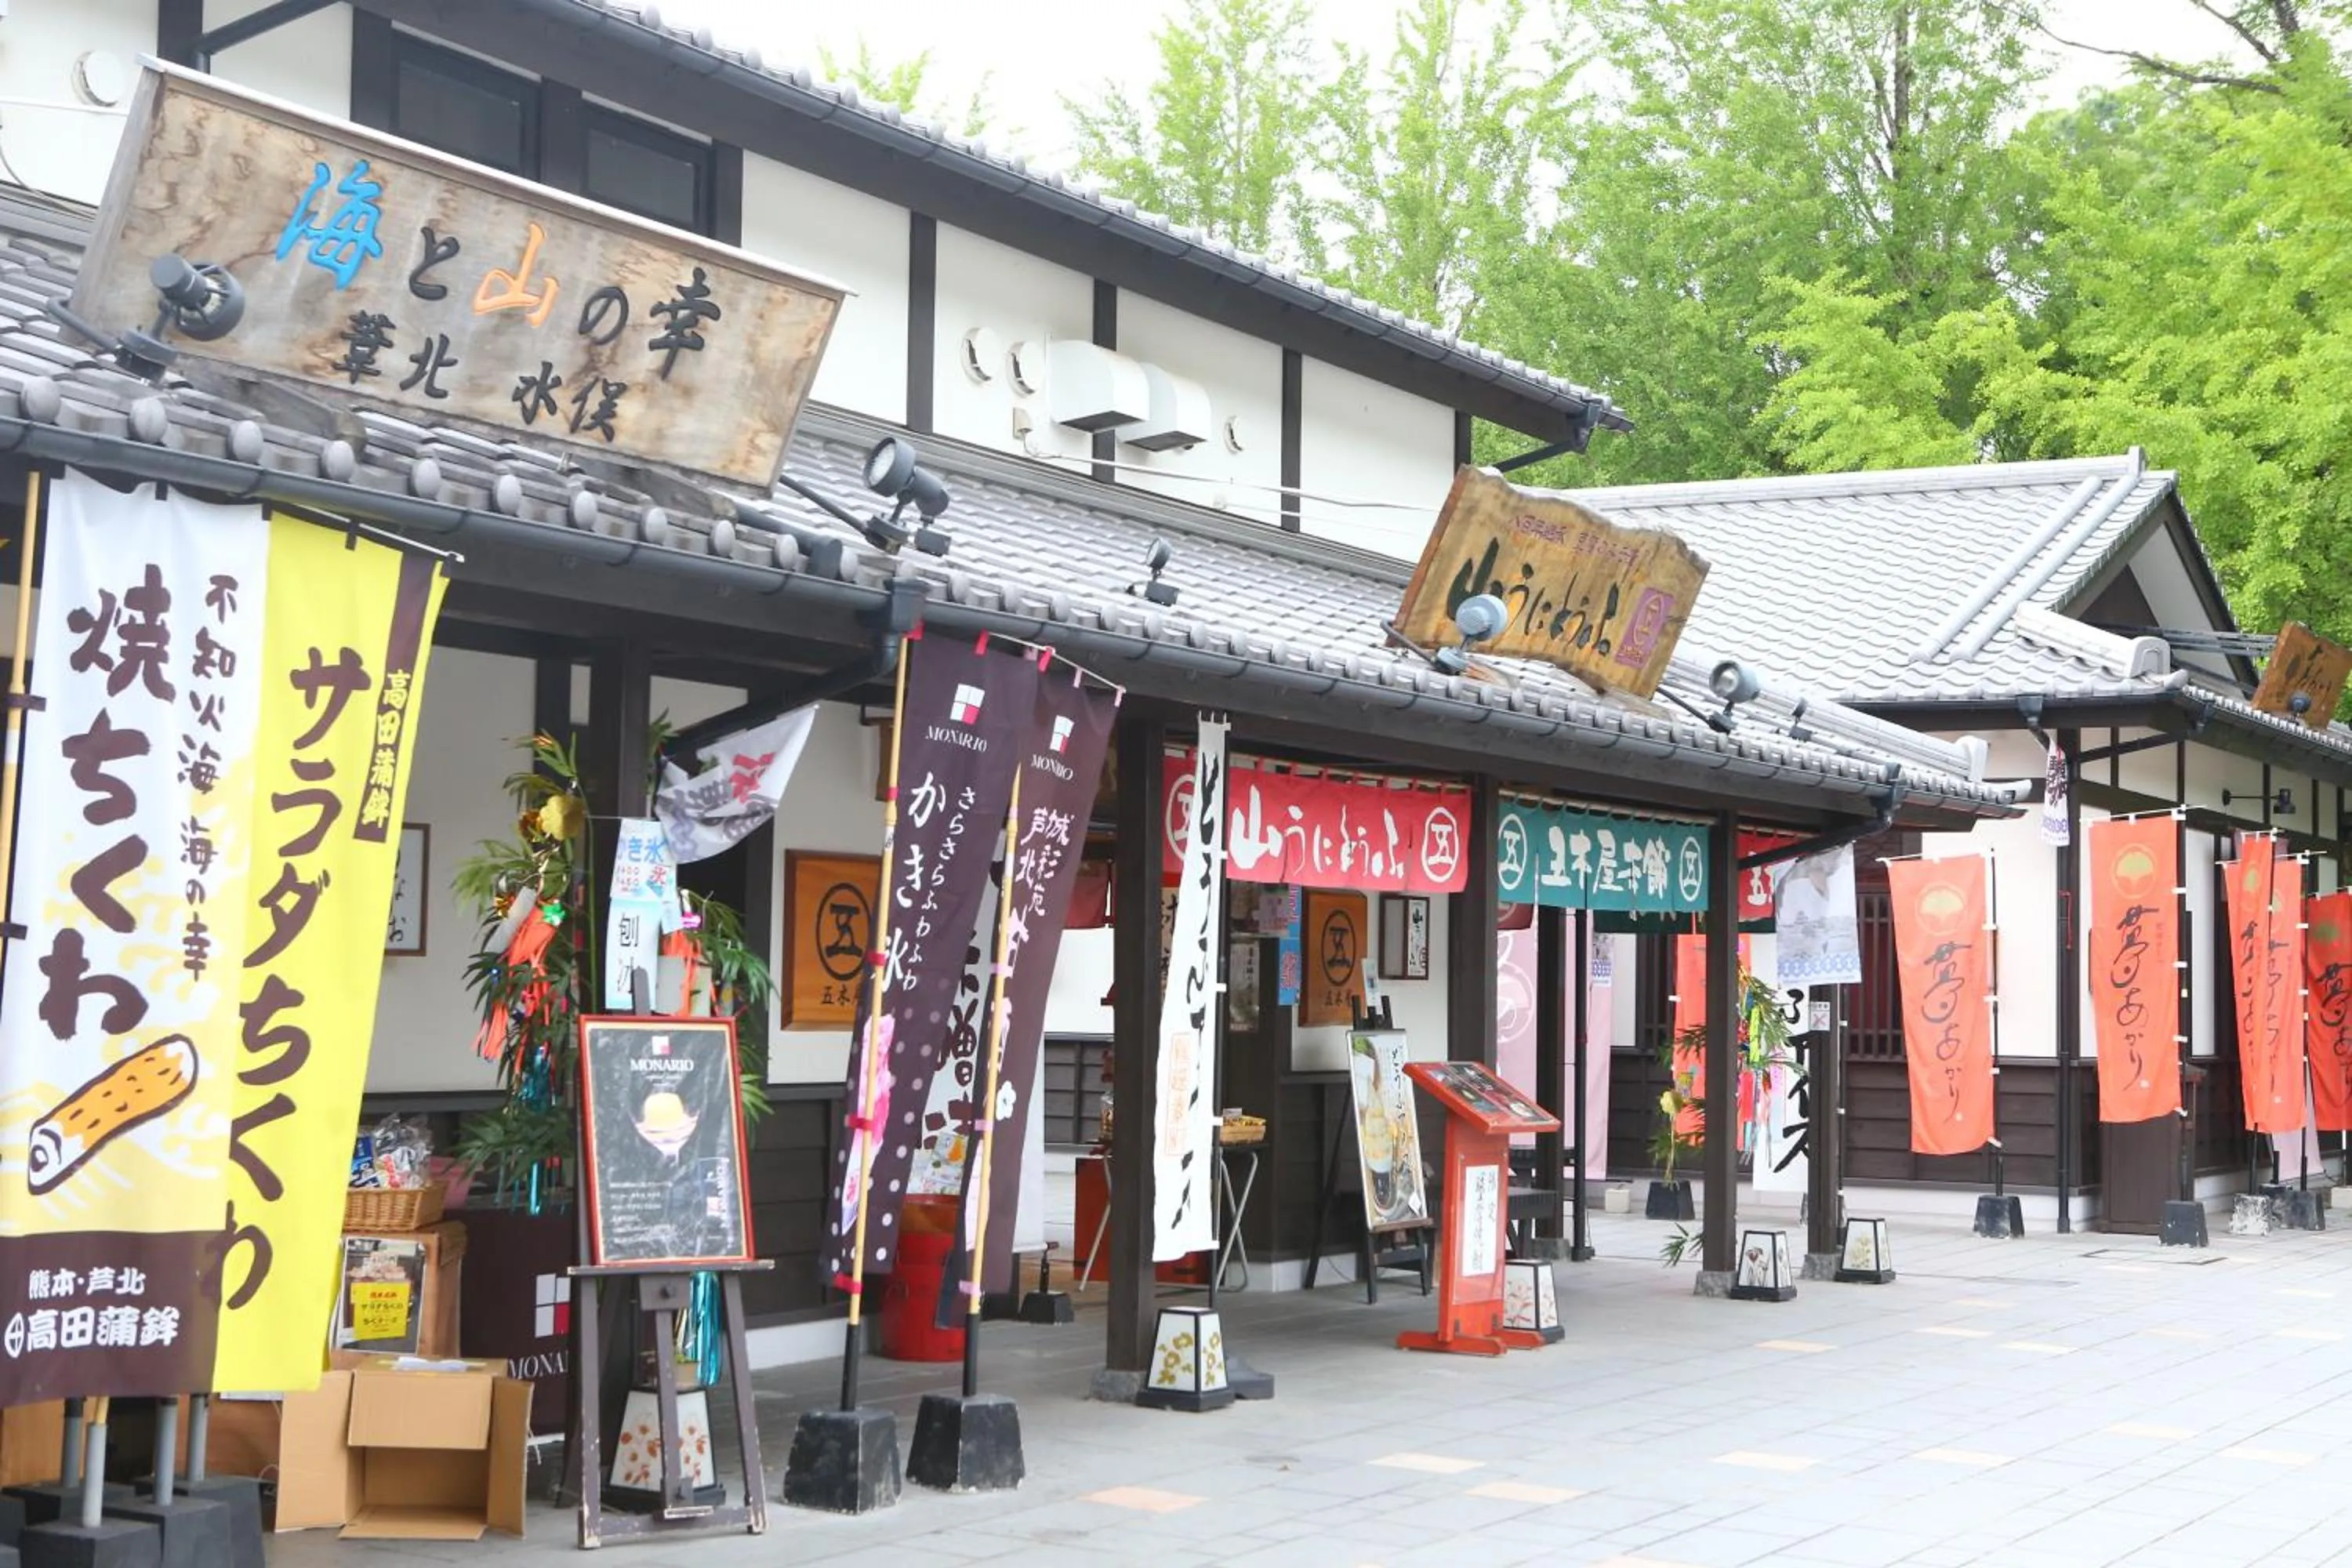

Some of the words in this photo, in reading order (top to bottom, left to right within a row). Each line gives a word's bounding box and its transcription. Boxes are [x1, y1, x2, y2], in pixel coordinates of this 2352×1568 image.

[274, 158, 721, 381] 海と山の幸
[332, 309, 459, 399] 葦北
[511, 361, 627, 441] 水俣
[361, 670, 412, 827] 高田蒲鉾
[925, 724, 988, 753] MONARIO
[38, 564, 176, 1040] 焼ちくわ
[1229, 784, 1405, 880] 山うにとうふ
[872, 771, 946, 993] かき氷
[903, 786, 977, 991] さらさらふわふわ
[1541, 826, 1671, 899] 五木屋本舗
[202, 646, 372, 1310] サラダちくわ
[821, 983, 859, 1007] 五木
[2110, 904, 2159, 1091] 夢あかり
[630, 1058, 695, 1073] MONARIO
[27, 1305, 181, 1352] 高田蒲鉾
[29, 1266, 147, 1300] 熊本・芦北
[510, 1349, 568, 1380] MONA
